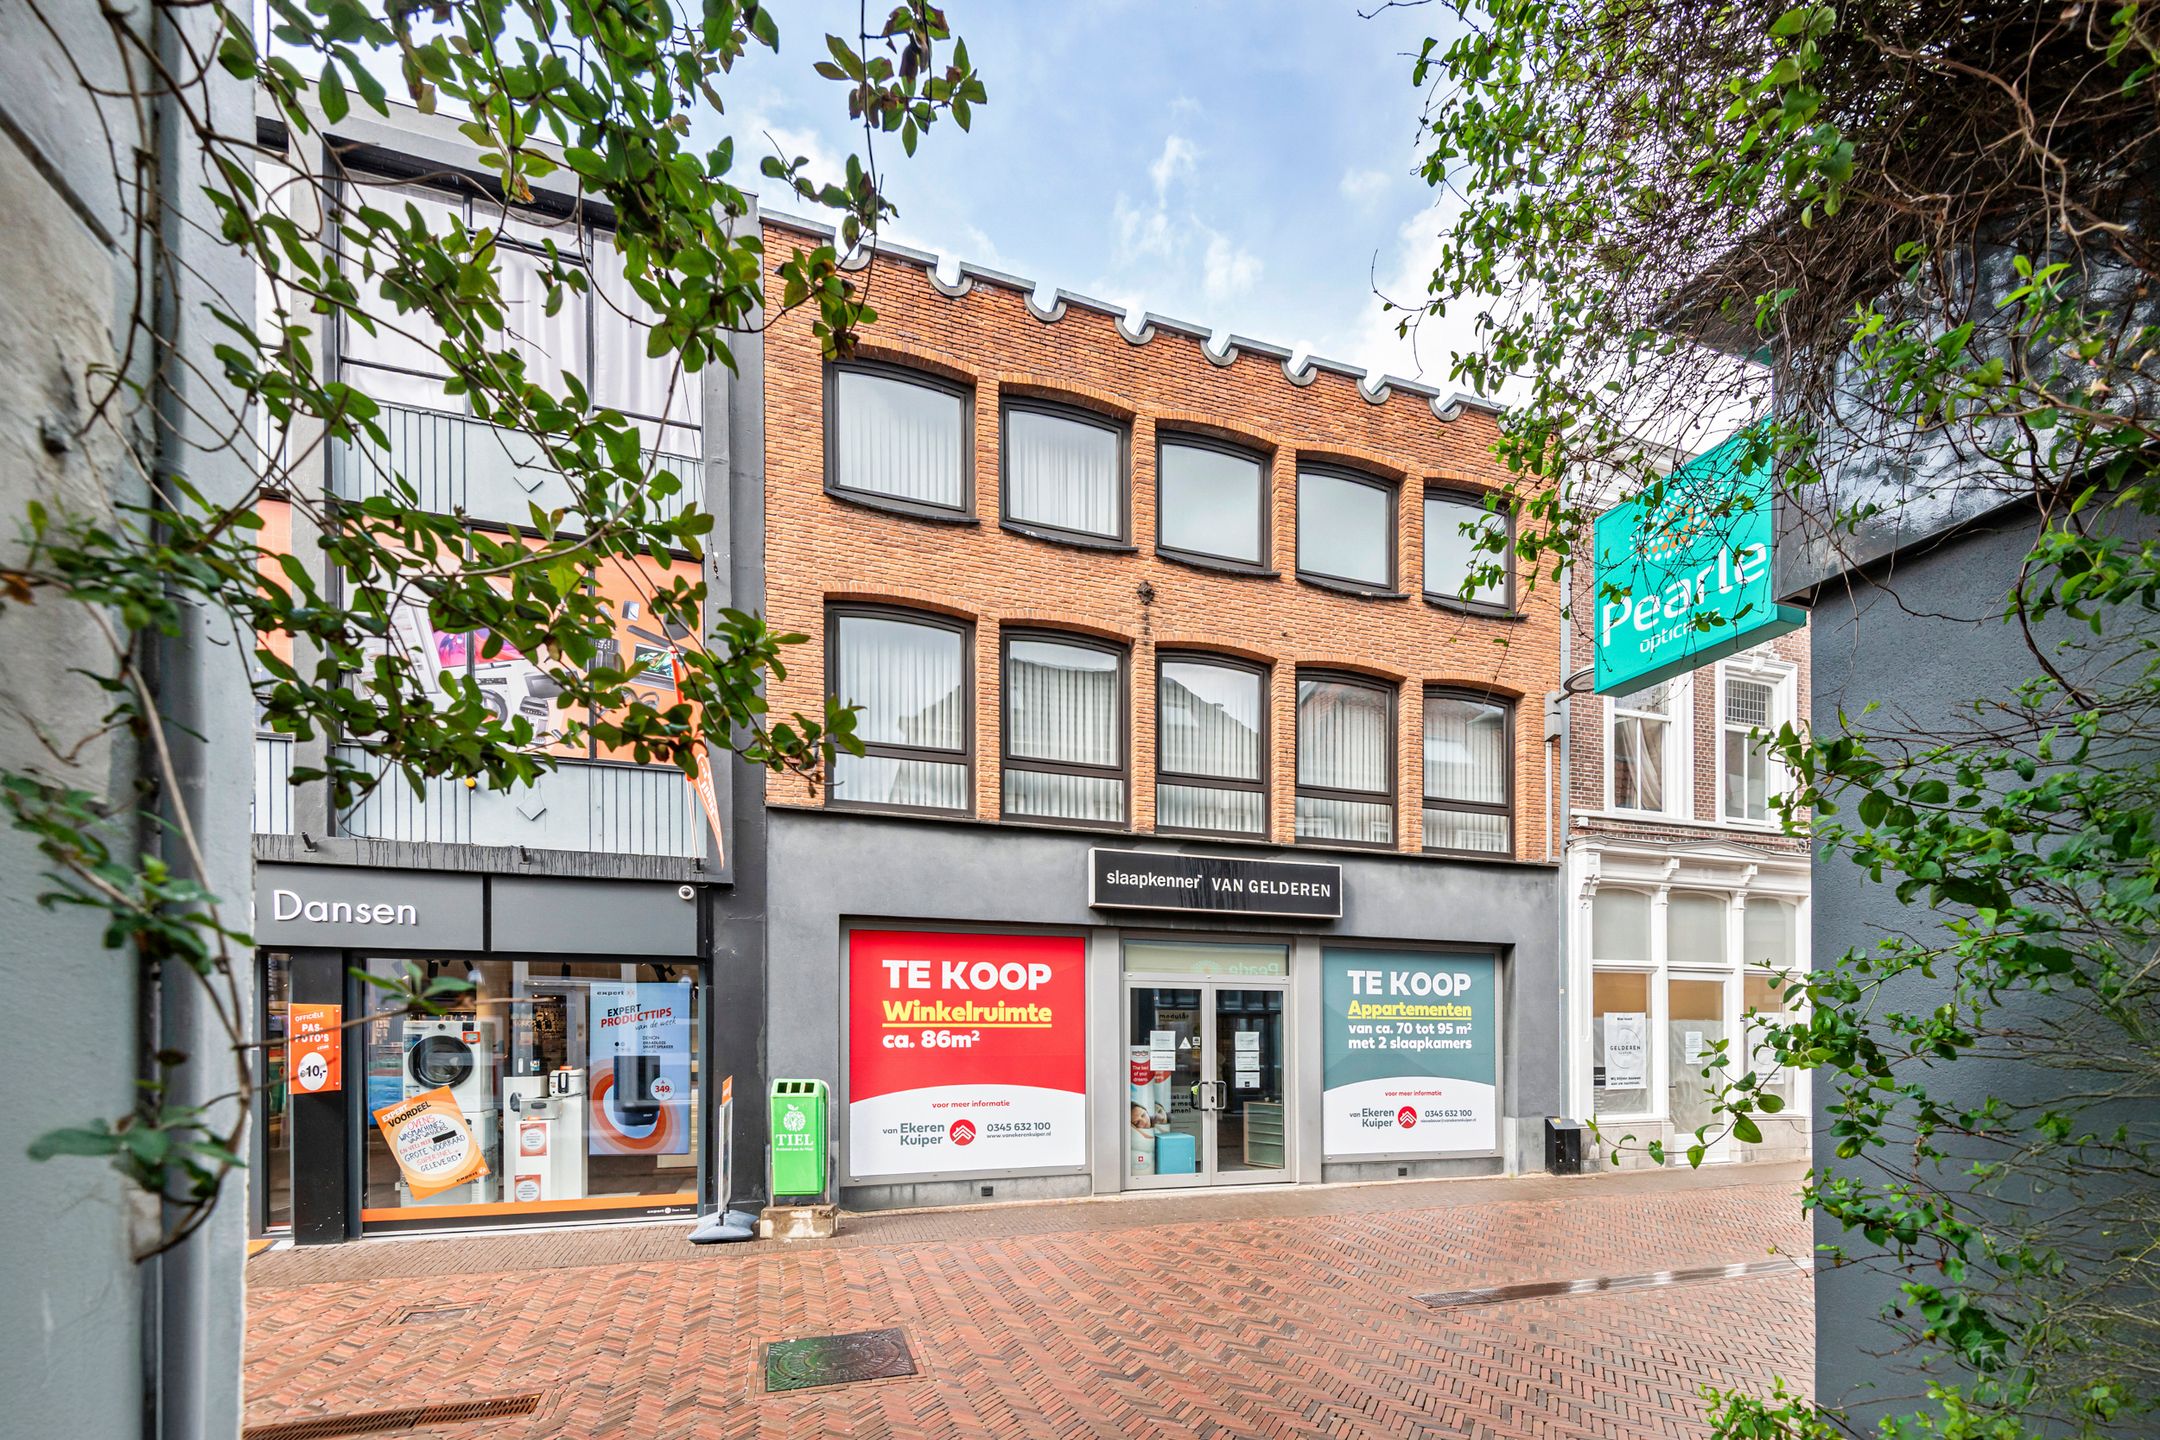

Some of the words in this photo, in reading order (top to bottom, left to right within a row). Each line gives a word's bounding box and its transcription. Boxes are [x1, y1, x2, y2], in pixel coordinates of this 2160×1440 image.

[1602, 541, 1767, 648] Pearle
[1211, 877, 1243, 893] VAN
[1248, 879, 1331, 897] GELDEREN
[273, 889, 418, 925] Dansen
[882, 959, 931, 989] TE
[942, 960, 1052, 991] KOOP
[1347, 970, 1383, 995] TE
[1390, 971, 1472, 997] KOOP
[607, 1003, 642, 1017] EXPERT
[882, 999, 1052, 1022] Winkelruimte
[1348, 1000, 1472, 1018] Appartementen
[600, 1007, 672, 1028] PRODUCTTIPS
[650, 1020, 657, 1029] de
[660, 1016, 677, 1026] week
[301, 1023, 324, 1032] PAS-
[1348, 1024, 1372, 1034] van
[1375, 1024, 1393, 1034] ca.
[1396, 1023, 1413, 1034] 70
[1415, 1023, 1435, 1034] tot
[1437, 1023, 1453, 1034] 95
[294, 1034, 330, 1043] FOTO'S
[882, 1033, 915, 1048] ca.
[1348, 1037, 1376, 1049] met
[1378, 1036, 1387, 1049] 2
[1390, 1036, 1472, 1052] slaapkamers
[388, 1101, 432, 1127] VOORDEEL
[1362, 1108, 1394, 1117] Ekeren
[1425, 1110, 1443, 1118] 0345
[1459, 1109, 1473, 1117] 100
[407, 1114, 436, 1130] OVENS
[900, 1122, 945, 1133] Ekeren
[987, 1123, 1012, 1132] 0345
[1014, 1122, 1032, 1131] 632
[1034, 1121, 1051, 1130] 100
[1362, 1118, 1393, 1129] Kuiper
[399, 1120, 445, 1141] WASMACHINES
[775, 1133, 814, 1146] TIEL
[900, 1134, 943, 1148] Kuiper
[404, 1147, 429, 1162] GROTE
